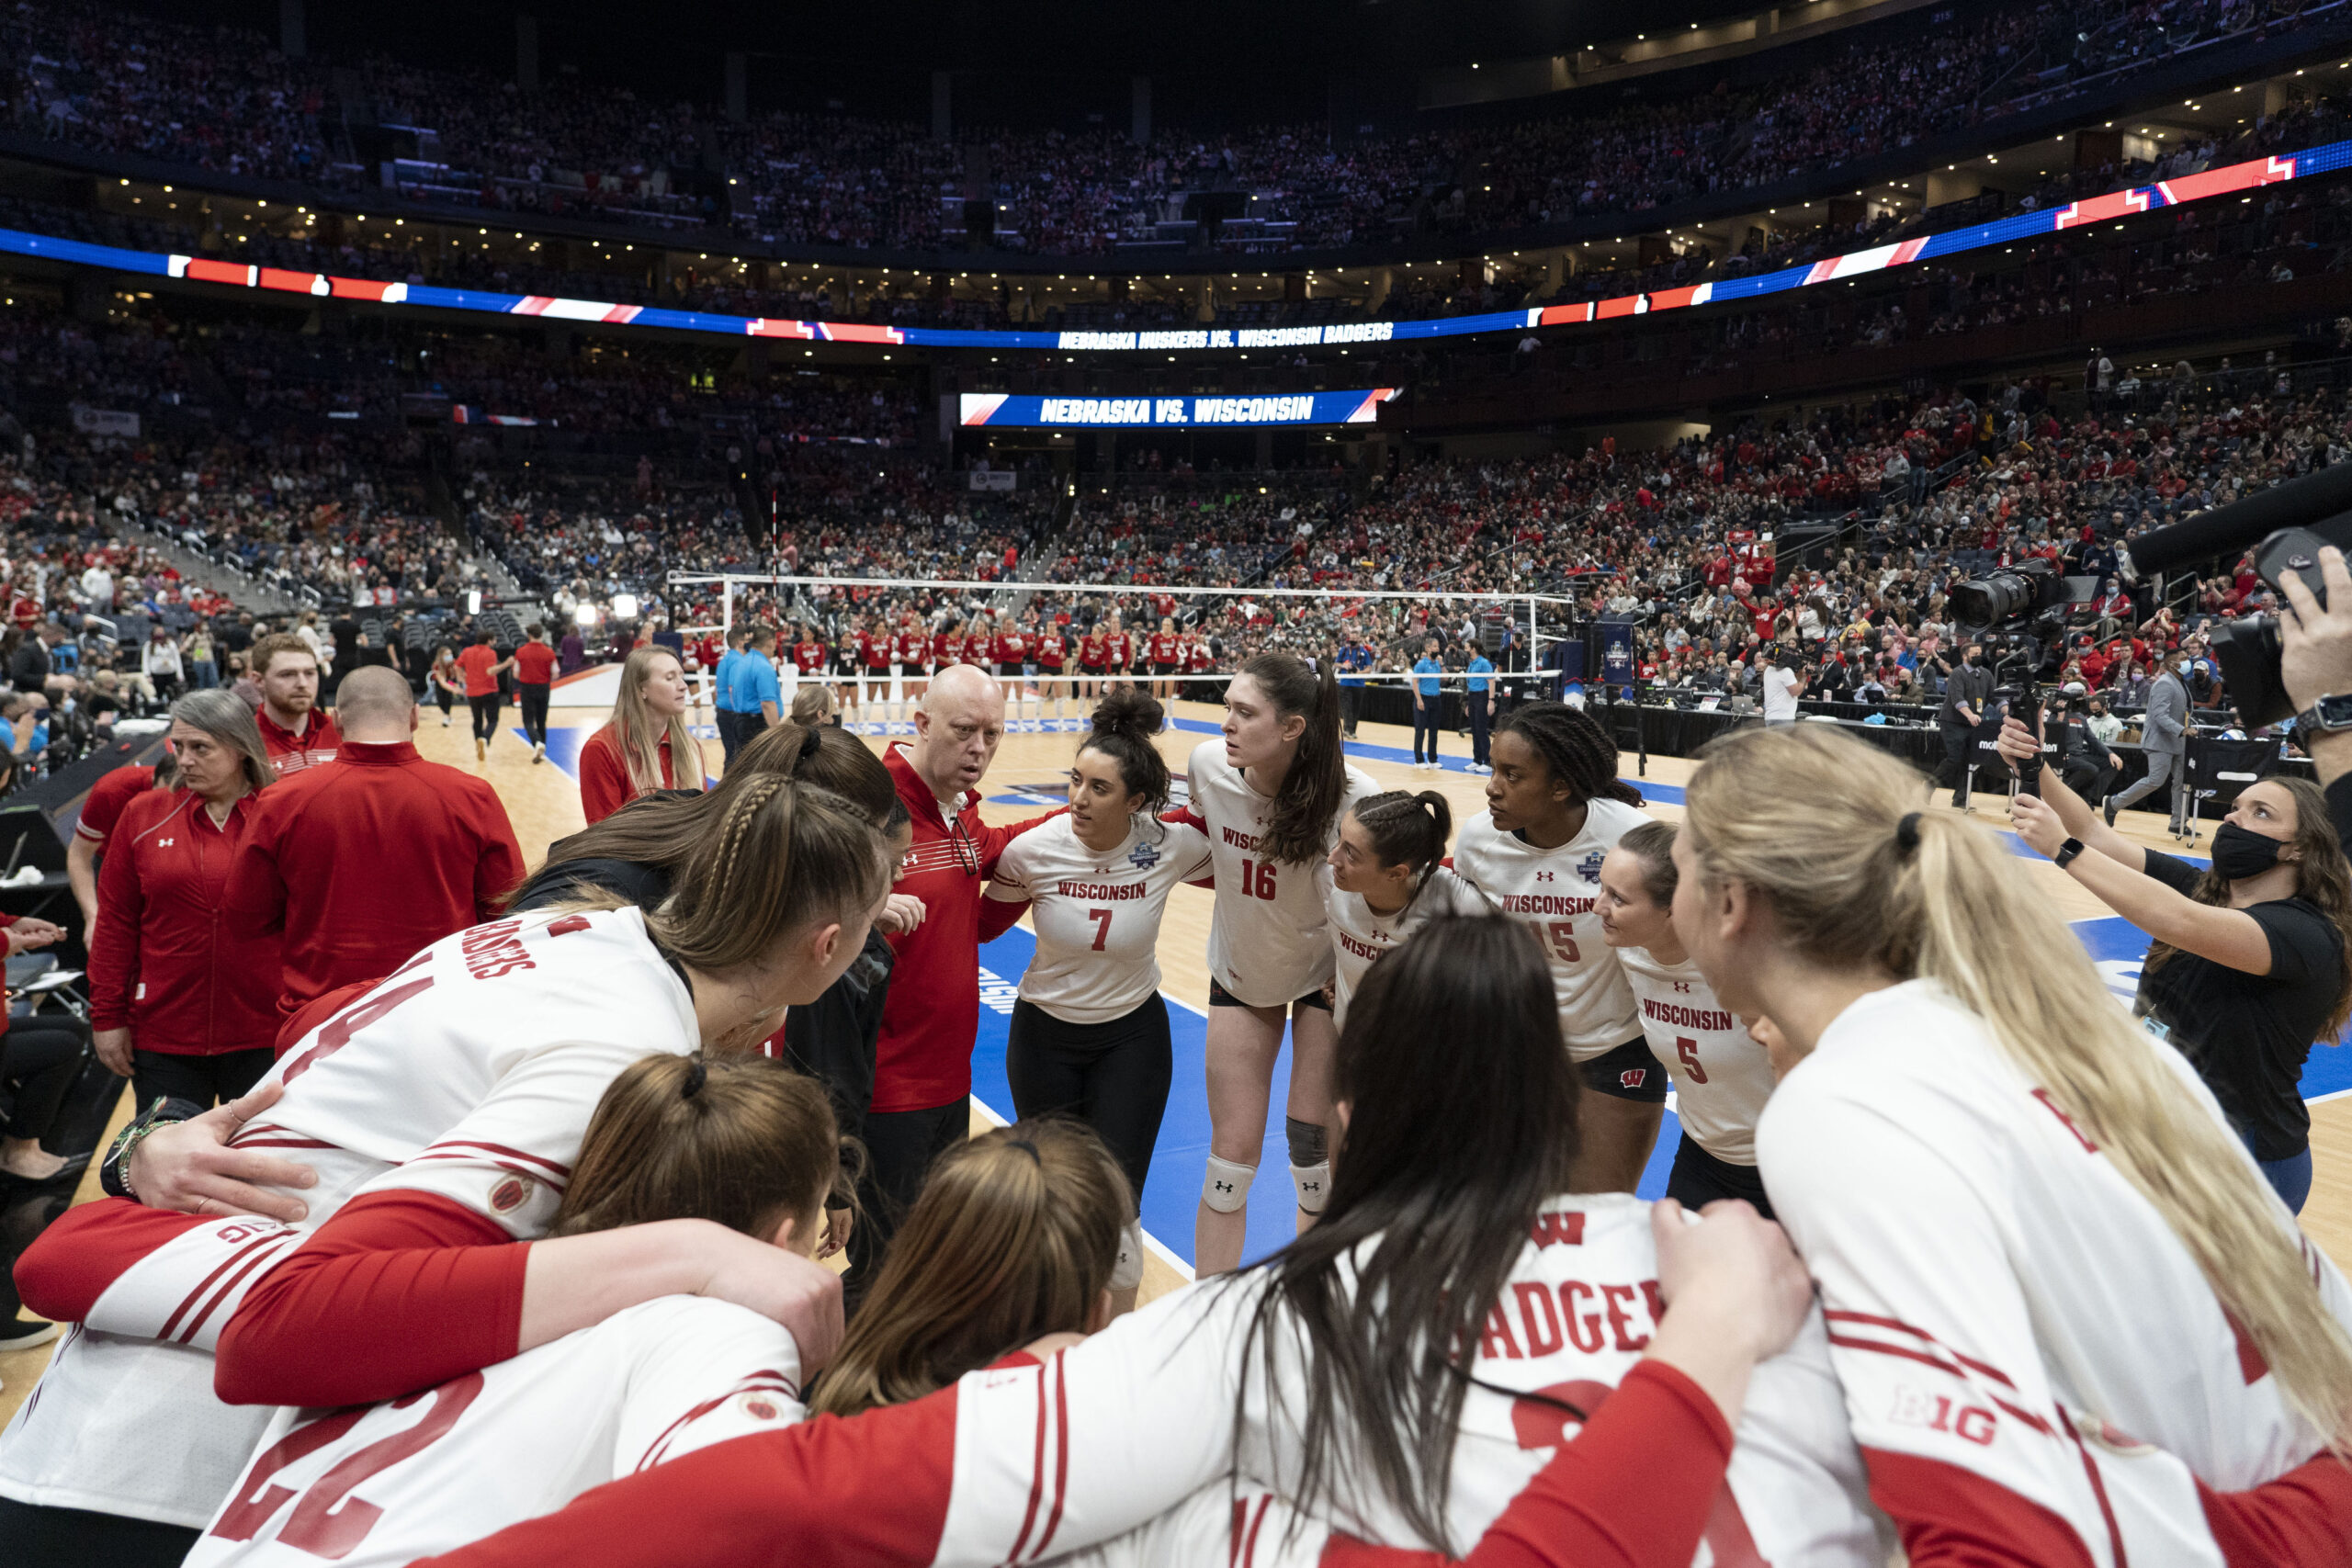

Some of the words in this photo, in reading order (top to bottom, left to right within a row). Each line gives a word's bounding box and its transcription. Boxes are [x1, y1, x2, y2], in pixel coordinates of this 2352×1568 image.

[1057, 331, 1137, 350] NEBRASKA
[1138, 330, 1208, 349] HUSKERS
[1210, 329, 1234, 348] VS.
[1238, 325, 1322, 347] WISCONSIN
[1323, 321, 1394, 344] BADGERS
[1039, 398, 1151, 423] NEBRASKA
[1155, 398, 1189, 423] VS.
[1193, 396, 1315, 423] WISCONSIN
[1979, 740, 1998, 750] mol
[1057, 881, 1147, 901] WISCONSIN
[1242, 859, 1277, 900] 16
[1501, 895, 1596, 916] WISCONSIN
[1089, 908, 1113, 952] 7
[1529, 920, 1581, 963] 15
[1644, 998, 1734, 1031] WISCONSIN
[1677, 1036, 1709, 1085] 5
[1620, 1068, 1646, 1089] W
[209, 1371, 484, 1561] 22
